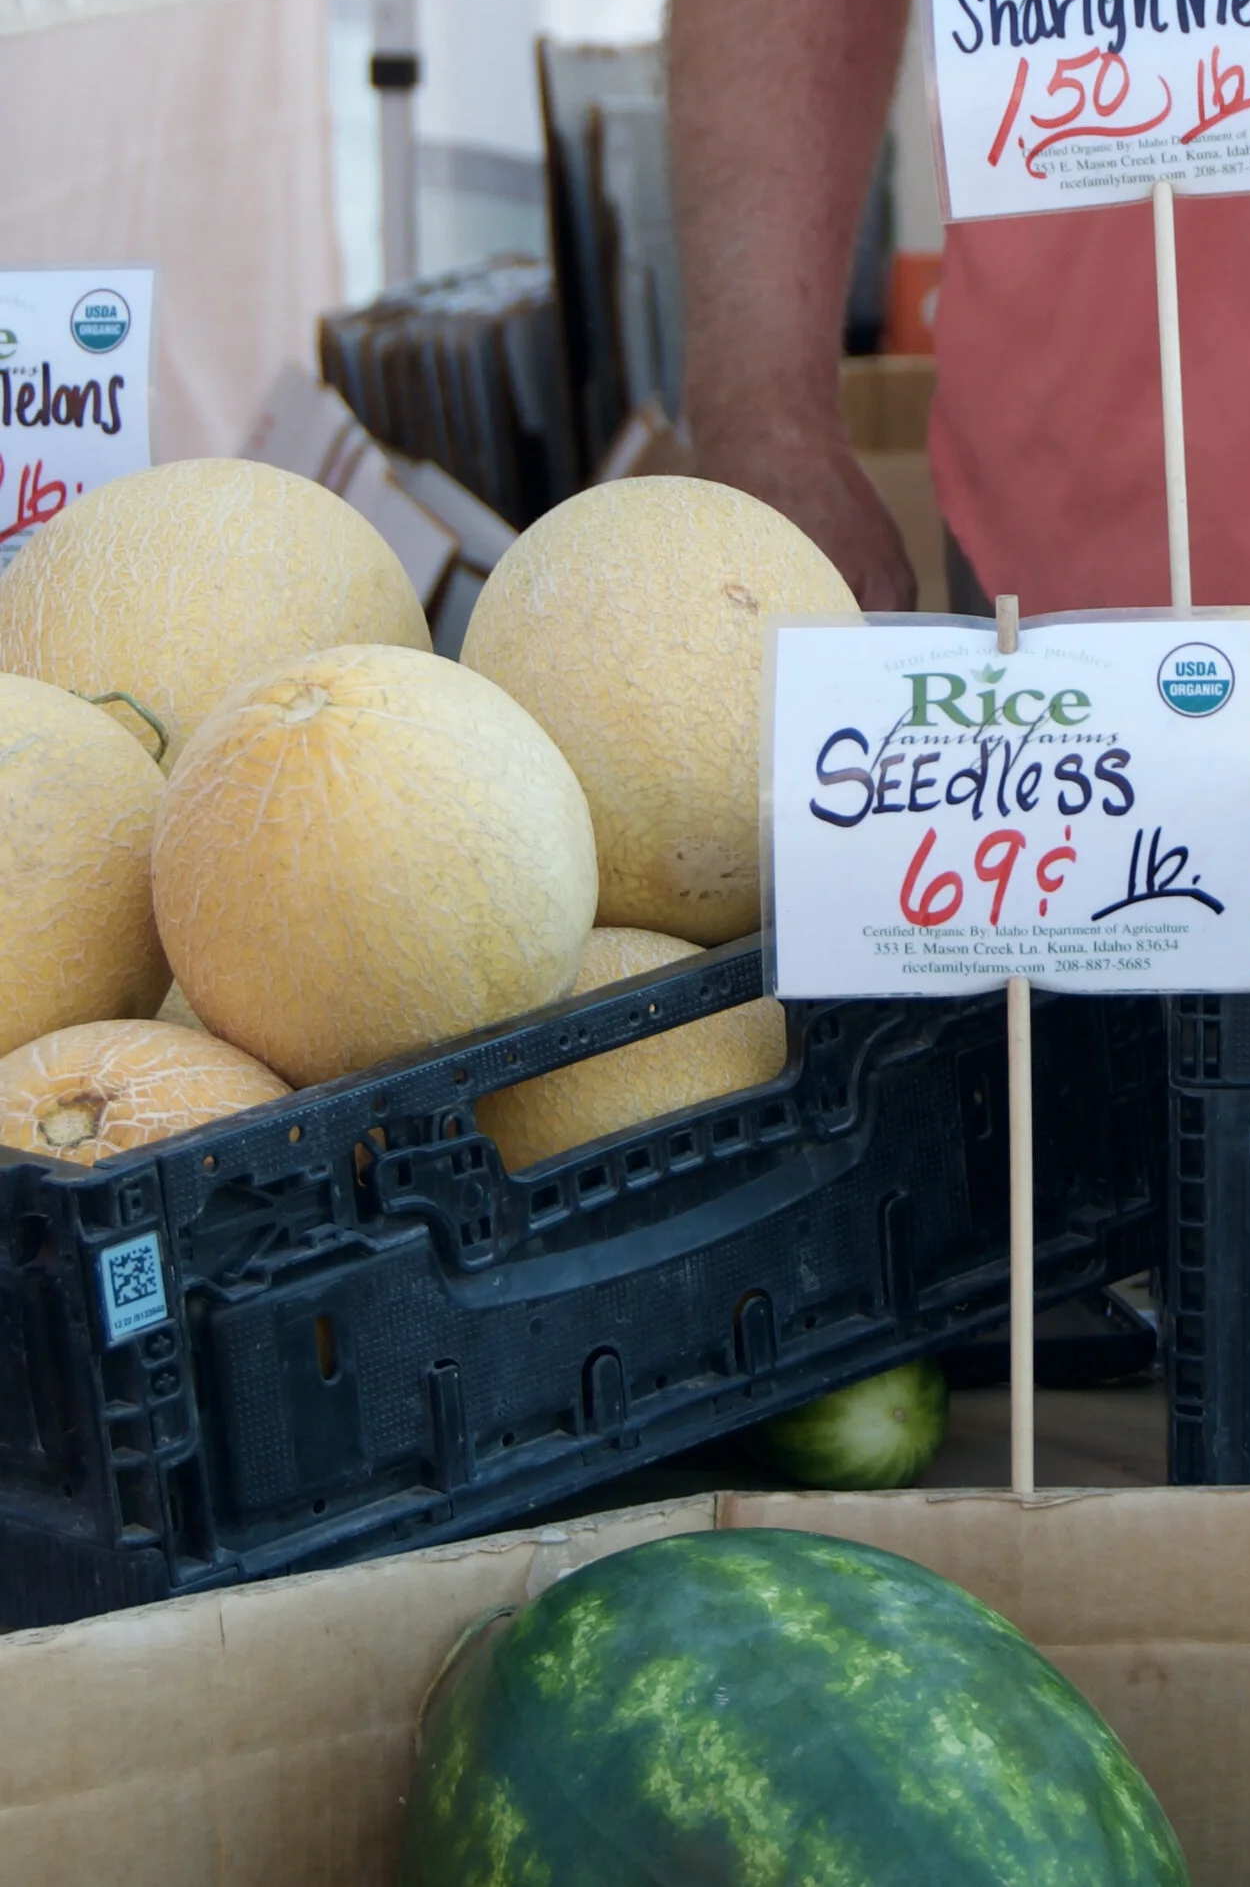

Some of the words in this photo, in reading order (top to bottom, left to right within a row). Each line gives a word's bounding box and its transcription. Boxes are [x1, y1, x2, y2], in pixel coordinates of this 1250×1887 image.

[1071, 142, 1112, 156] Organic
[1138, 136, 1169, 148] Idaho
[1236, 129, 1247, 140] of
[1077, 158, 1117, 171] Mason
[1121, 154, 1157, 168] Creek
[85, 305, 118, 319] USDA
[78, 323, 122, 337] ORGANIC
[1175, 660, 1218, 677] USDA
[1169, 683, 1225, 697] ORGANIC
[902, 672, 1092, 728] Rice
[862, 925, 915, 938] Certified
[918, 925, 965, 940] Organic
[995, 925, 1029, 937] Idaho
[1032, 924, 1101, 938] Department
[1105, 923, 1117, 935] of
[1122, 922, 1189, 936] Agriculture
[874, 942, 900, 956] 353
[923, 942, 968, 955] Mason
[973, 942, 1014, 955] Creek
[1093, 940, 1132, 954] Idaho
[1136, 939, 1179, 952] 83634
[902, 960, 1045, 976] ricefamilyfarms.com
